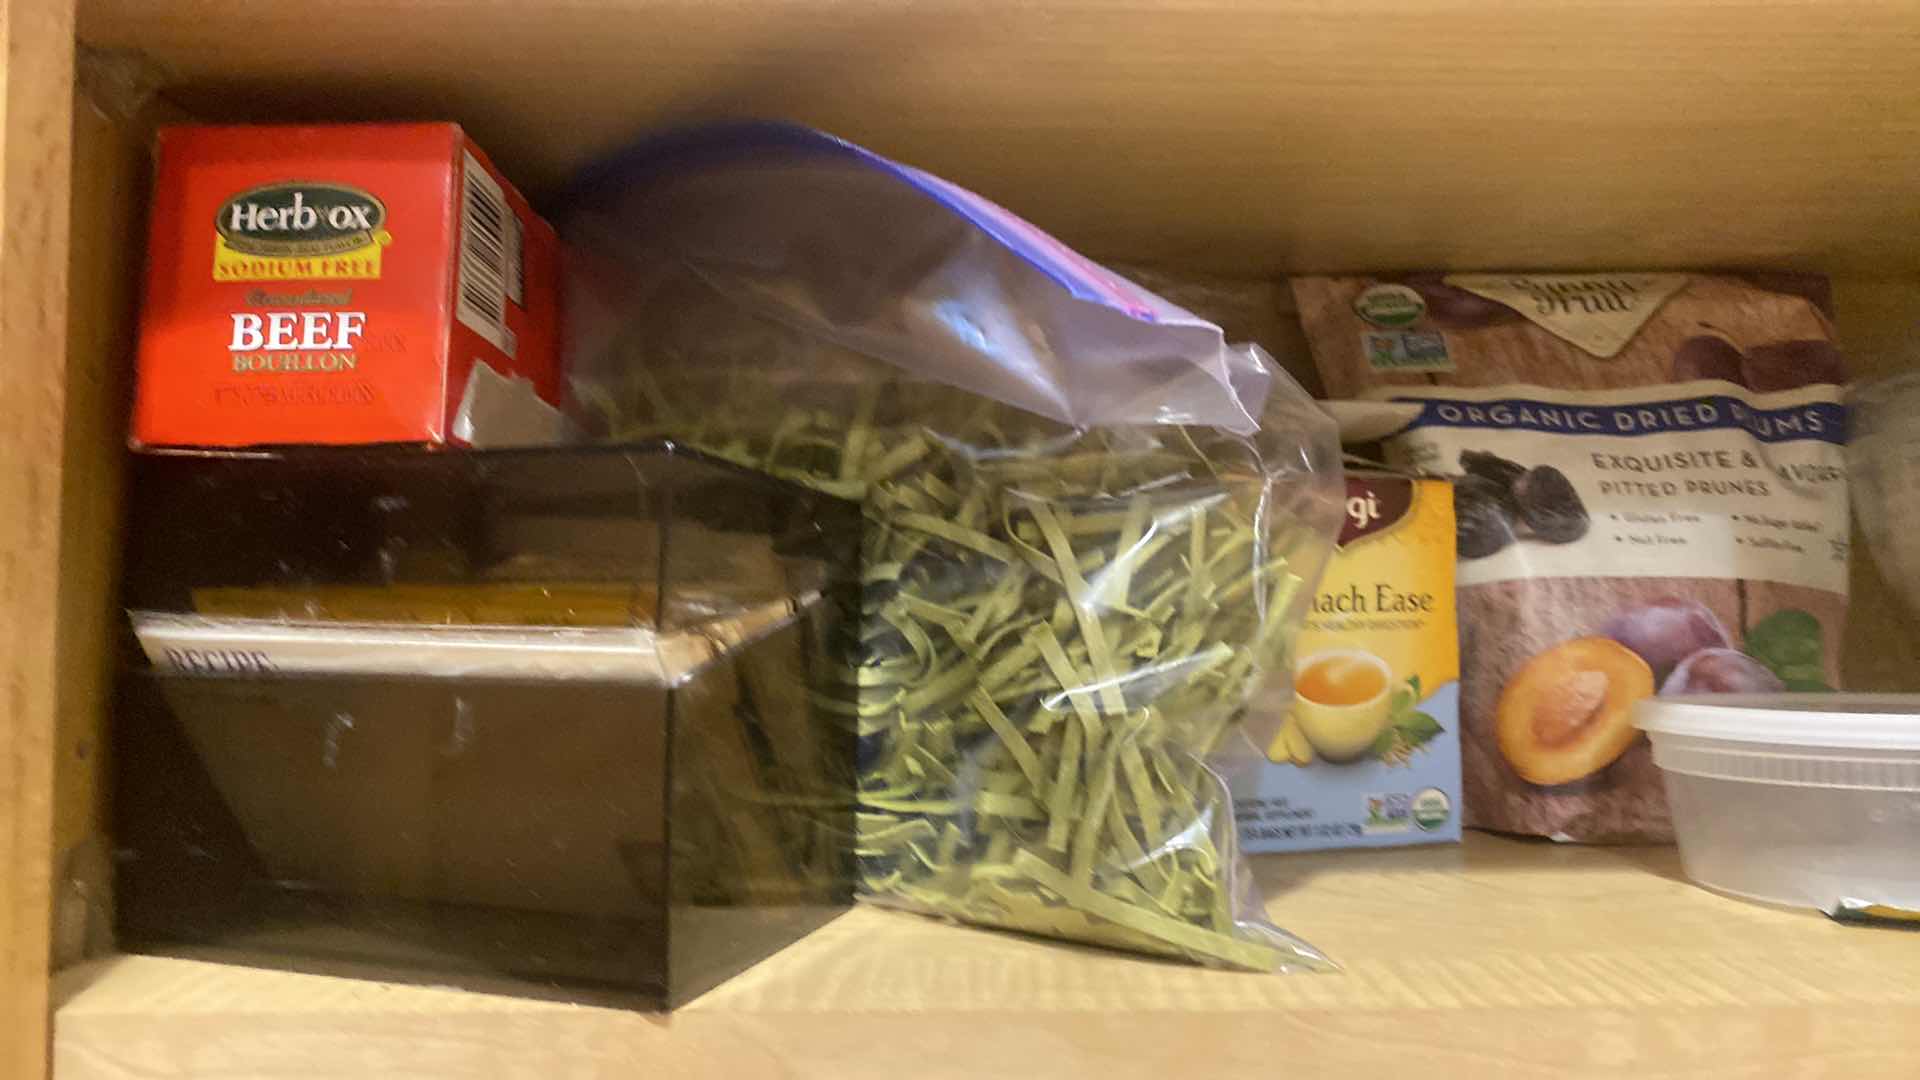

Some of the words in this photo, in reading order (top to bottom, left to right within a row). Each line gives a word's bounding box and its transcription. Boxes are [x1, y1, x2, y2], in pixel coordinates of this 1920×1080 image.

[219, 260, 314, 276] SODIUM
[321, 259, 374, 275] FREE
[227, 311, 367, 351] BEEF
[232, 352, 357, 372] BOUILLON
[1437, 403, 1602, 430] ORGANIC
[1615, 403, 1719, 432] DRIED
[1591, 450, 1733, 473] EXQUISITE
[1741, 450, 1760, 469] &
[1601, 481, 1677, 497] PITTED
[1685, 480, 1771, 497] PRUNES
[1375, 583, 1434, 613] Ease
